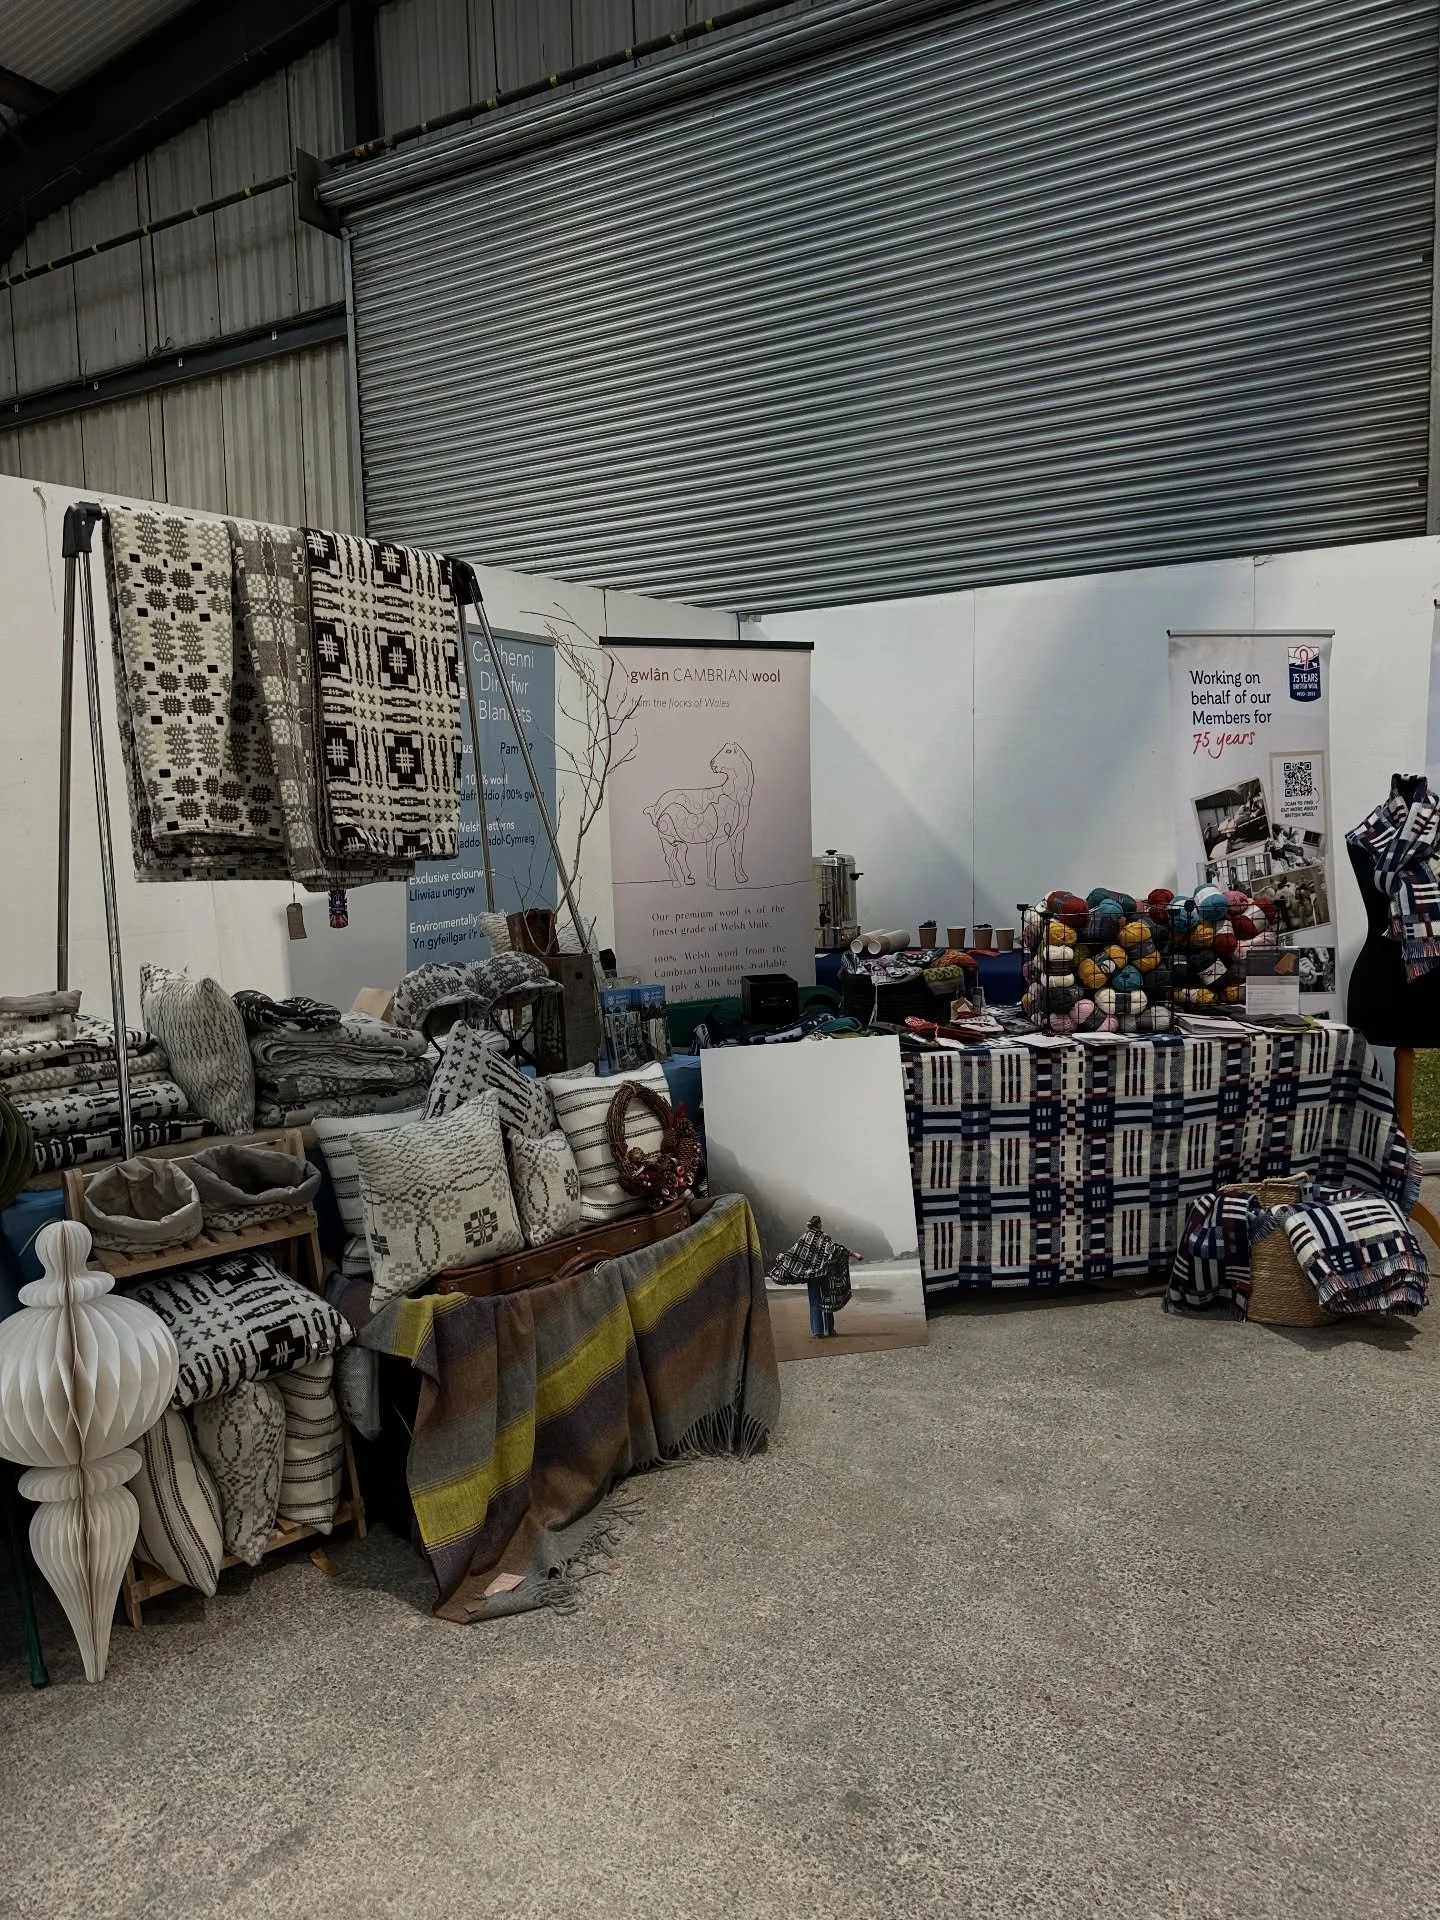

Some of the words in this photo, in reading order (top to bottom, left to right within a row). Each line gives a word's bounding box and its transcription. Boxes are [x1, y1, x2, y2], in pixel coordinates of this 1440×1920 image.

[472, 641, 534, 668] Cahenni
[630, 667, 669, 684] gwlân
[672, 668, 748, 682] CAMBRIAN
[752, 669, 781, 682] wool
[1189, 670, 1242, 688] Working
[1245, 674, 1261, 684] on
[1292, 673, 1300, 682] 75
[1300, 673, 1318, 682] YEARS
[631, 698, 650, 708] from
[653, 698, 666, 708] the
[668, 698, 692, 709] flocks
[694, 698, 703, 708] of
[704, 698, 730, 708] Wales
[1191, 690, 1231, 704] behalf
[1234, 690, 1247, 704] of
[1250, 694, 1272, 704] our
[1192, 710, 1250, 726] Members
[1254, 710, 1272, 724] for
[500, 742, 518, 754] Pam
[1192, 732, 1210, 754] 75
[1208, 731, 1256, 759] years
[506, 834, 535, 848] Cymreig
[409, 888, 440, 902] Lliwiau
[442, 885, 476, 899] unigryw
[651, 912, 670, 922] Our
[675, 911, 713, 922] premium
[719, 908, 740, 917] wool
[756, 906, 766, 914] of
[771, 904, 785, 914] the
[410, 912, 479, 934] Environmentally
[652, 926, 678, 937] finest
[680, 926, 706, 936] grade
[708, 924, 717, 932] of
[721, 922, 746, 932] Welsh
[412, 938, 425, 950] Yn
[428, 930, 466, 950] gyfeillgar
[468, 928, 477, 940] i'r
[684, 950, 710, 961] Welsh
[717, 948, 738, 958] wool
[745, 946, 766, 956] from
[772, 944, 787, 953] the
[654, 967, 697, 979] Cambrian
[749, 958, 788, 970] available
[694, 981, 701, 990] &
[707, 978, 721, 988] DK
